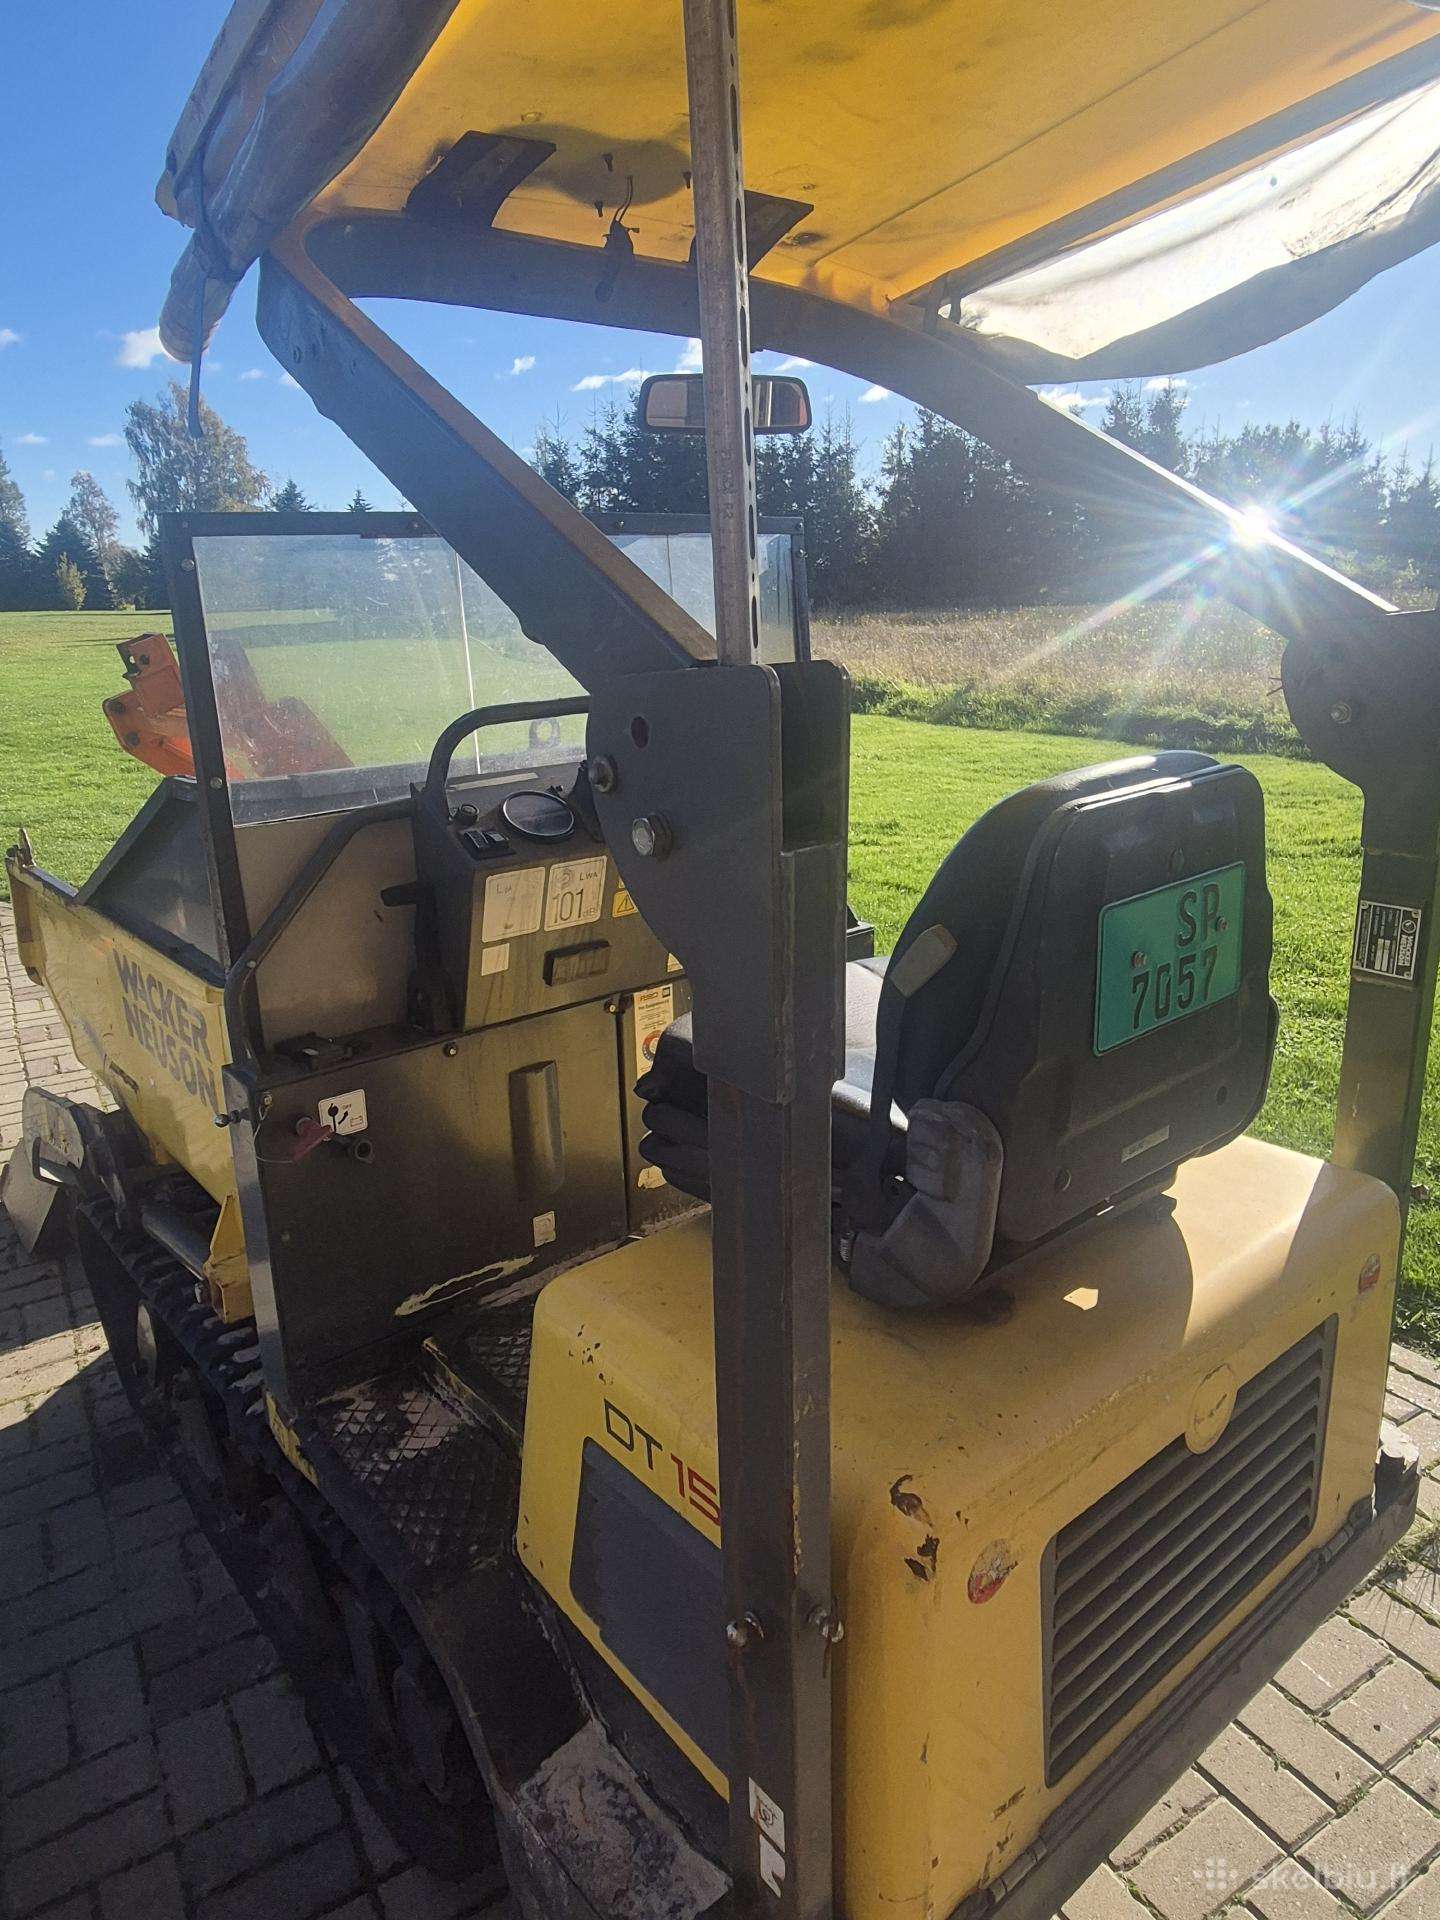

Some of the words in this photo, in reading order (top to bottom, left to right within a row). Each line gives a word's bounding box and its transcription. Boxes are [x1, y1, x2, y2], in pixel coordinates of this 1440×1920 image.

[552, 888, 584, 924] 101
[113, 948, 212, 1063] WACKER
[1131, 945, 1218, 1029] 7057
[122, 996, 219, 1116] NEUSON
[603, 1398, 663, 1470] DT
[670, 1452, 721, 1526] 15
